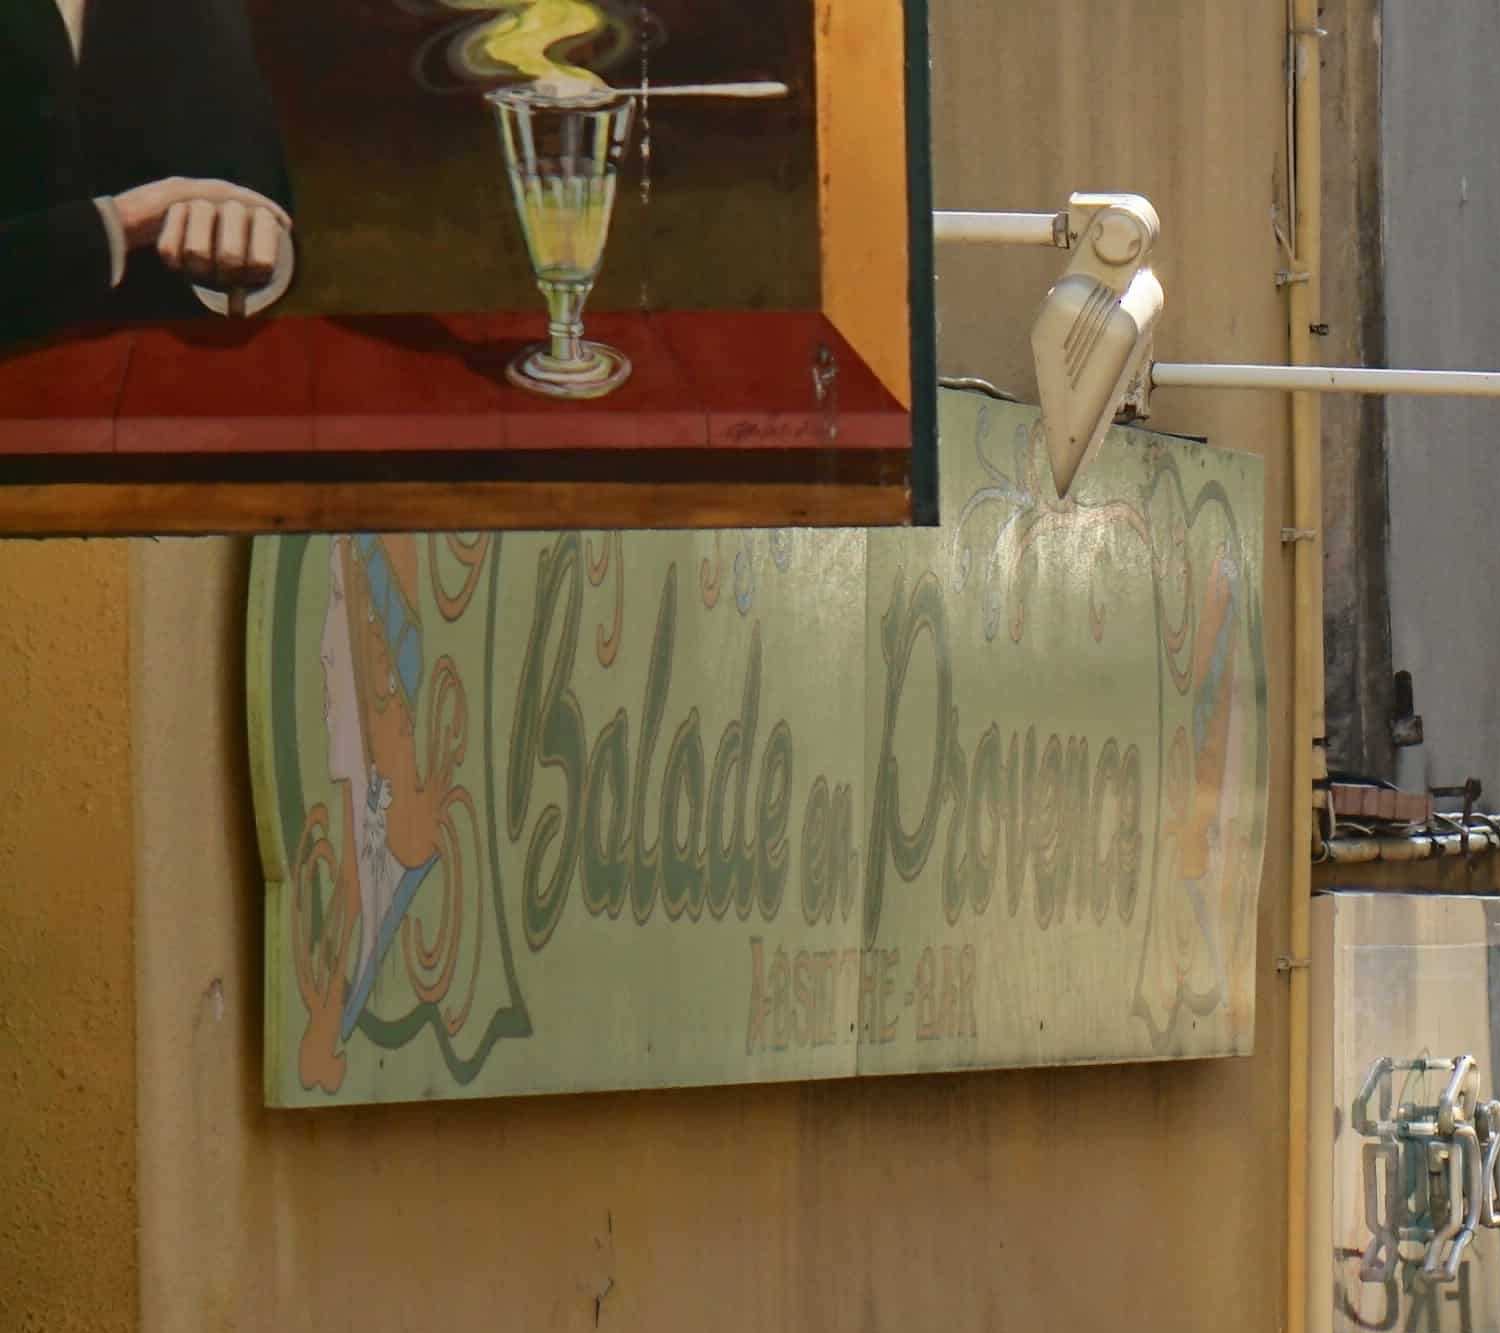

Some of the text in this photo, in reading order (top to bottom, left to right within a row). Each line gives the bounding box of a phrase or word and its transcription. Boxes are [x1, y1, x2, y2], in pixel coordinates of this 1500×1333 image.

[509, 530, 1143, 951] Balade en Provence
